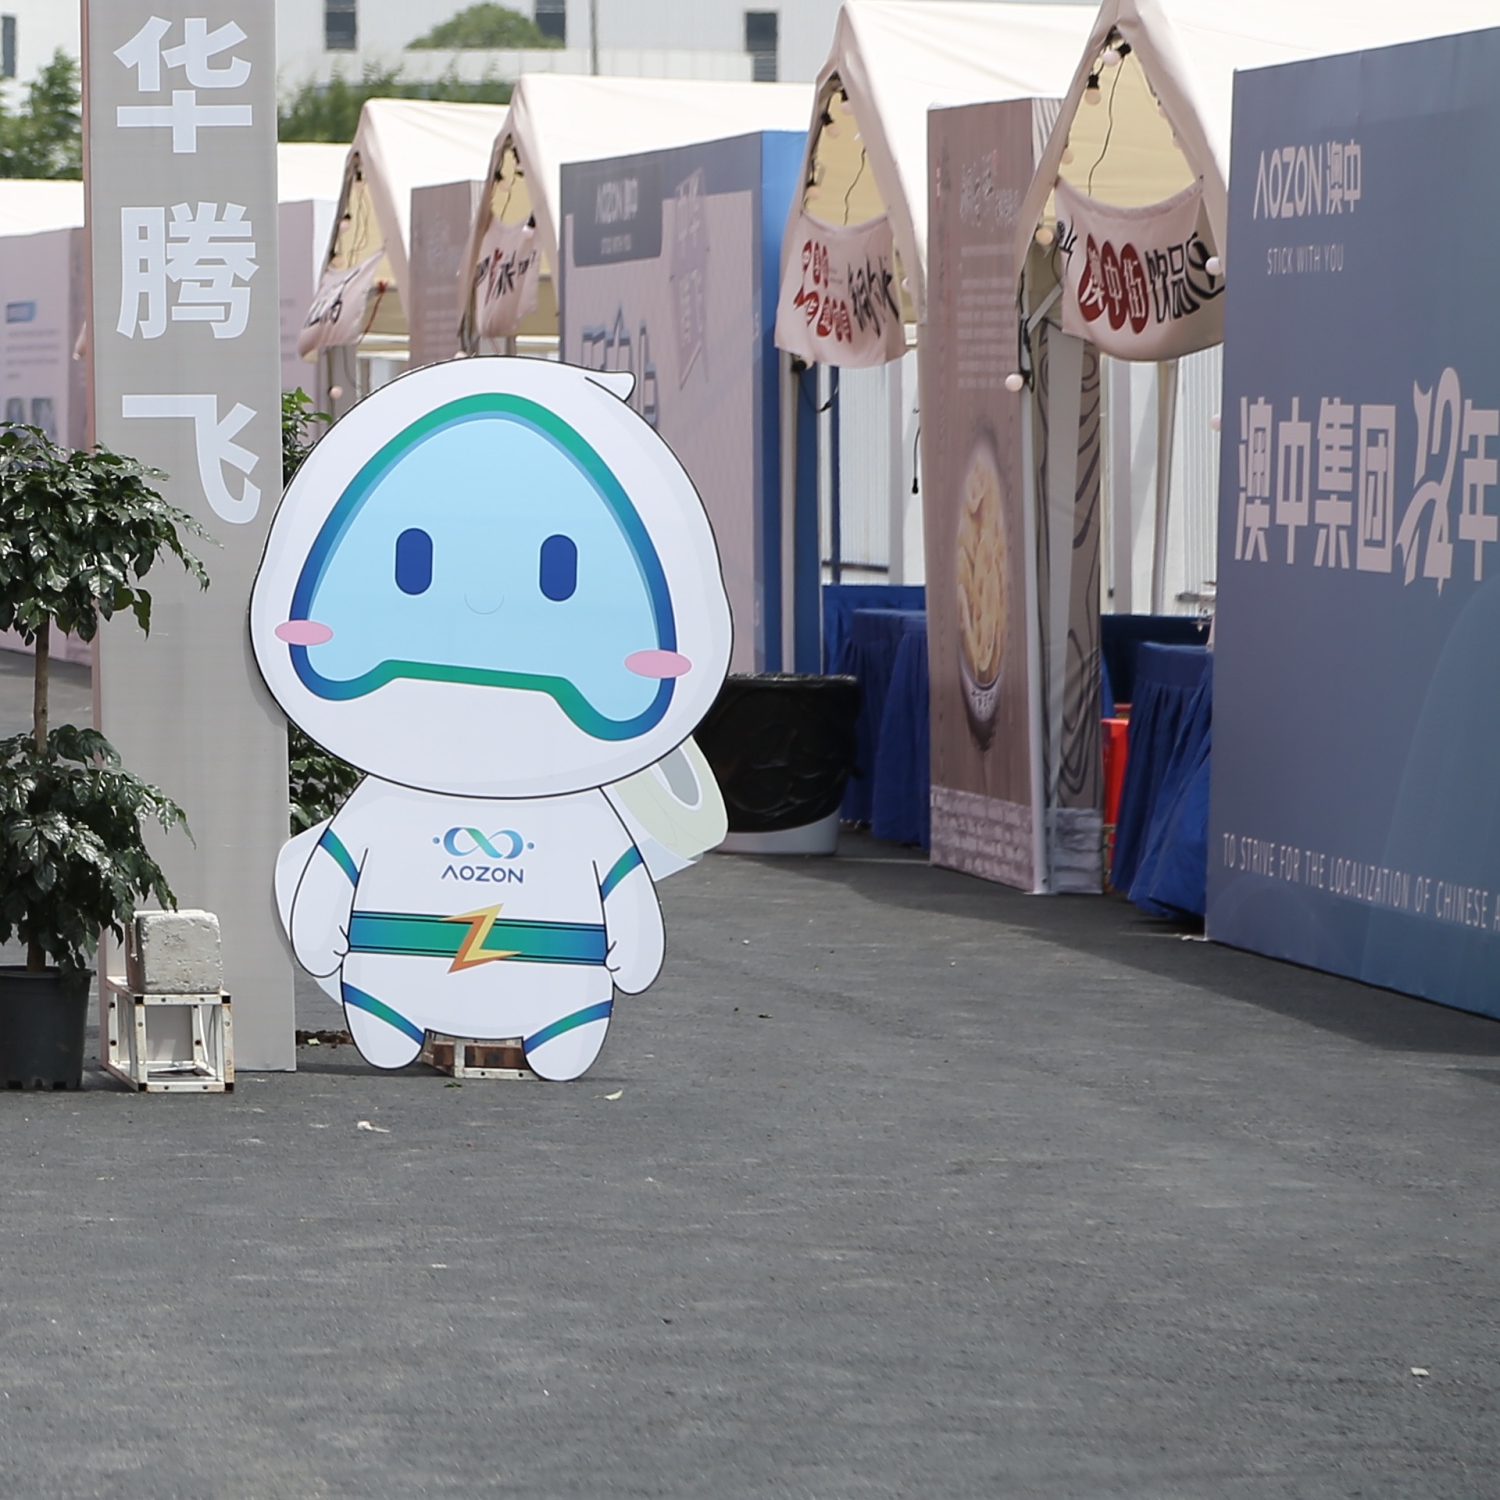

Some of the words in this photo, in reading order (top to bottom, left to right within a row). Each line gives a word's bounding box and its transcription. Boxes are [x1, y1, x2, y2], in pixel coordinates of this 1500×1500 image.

[1223, 832, 1235, 868] TO
[1240, 835, 1275, 877] STRIVE
[1280, 844, 1299, 883] FOR
[1305, 850, 1326, 889] THE
[1329, 856, 1411, 910] LOCALIZATION
[1415, 875, 1431, 914] OF
[1436, 880, 1489, 929] CHINESE
